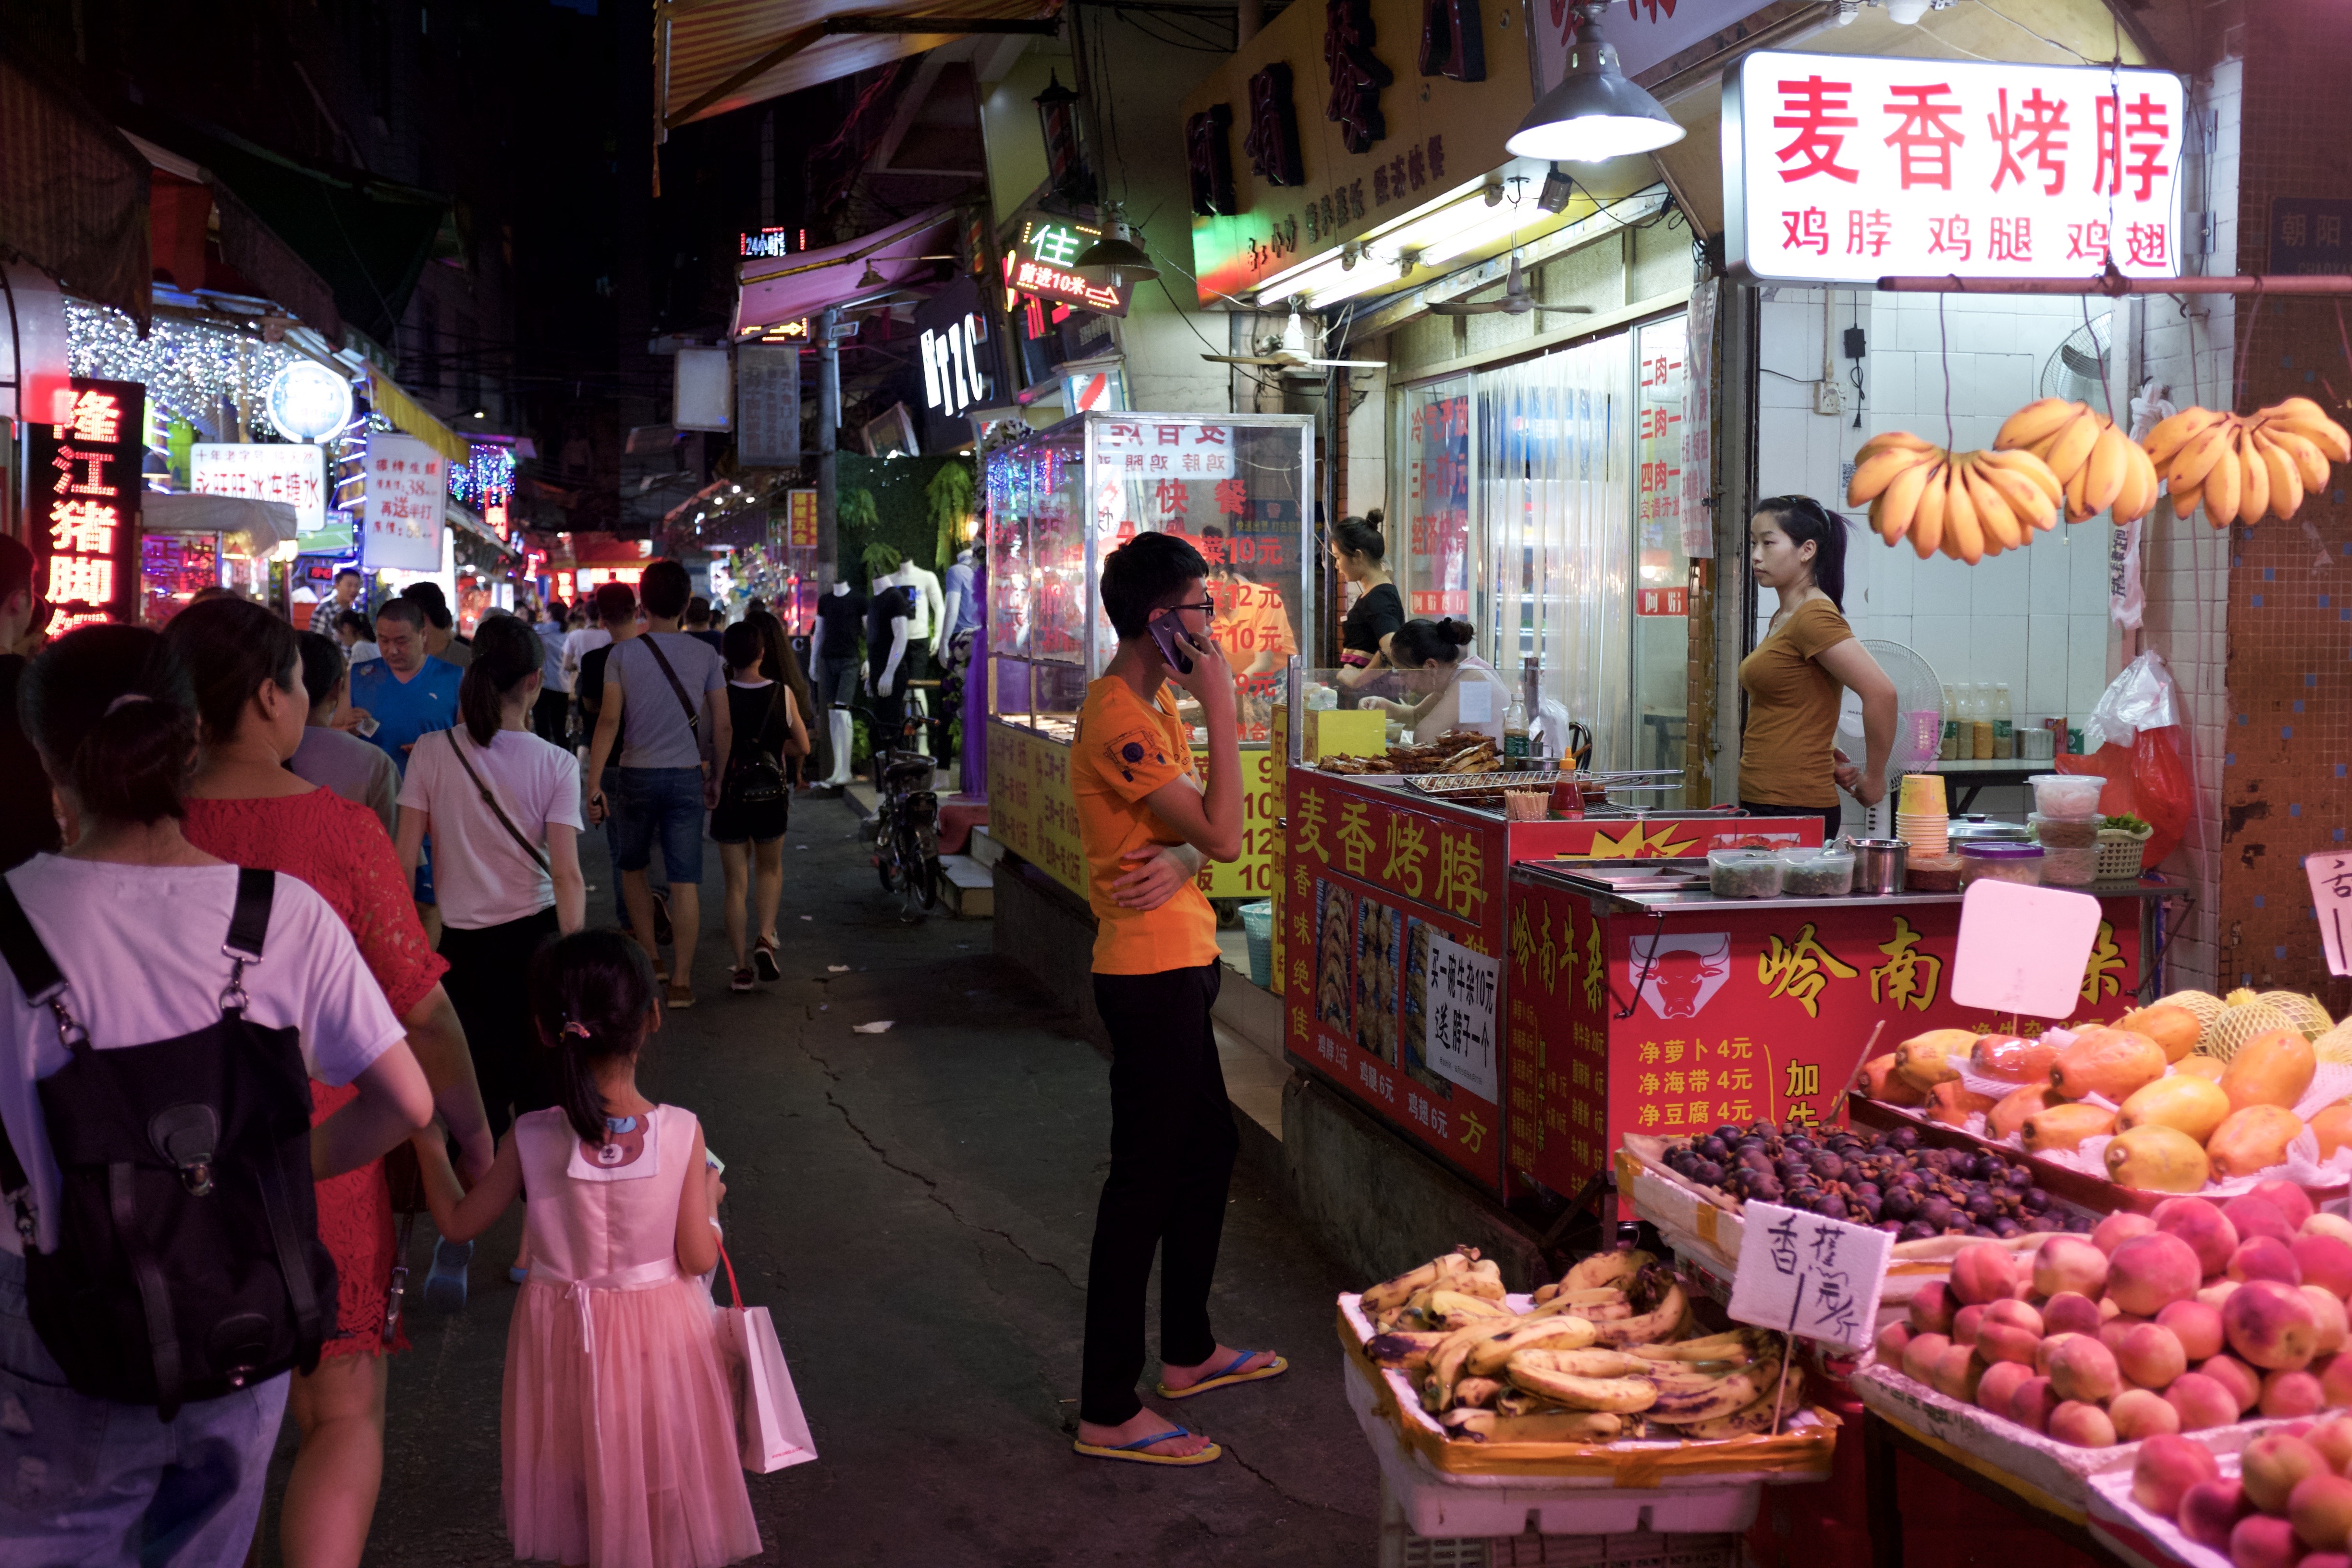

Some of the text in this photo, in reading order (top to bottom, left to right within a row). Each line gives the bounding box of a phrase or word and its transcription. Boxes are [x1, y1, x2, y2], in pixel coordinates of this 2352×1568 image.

[1773, 74, 2170, 202] 麦香烤脖
[1781, 206, 2168, 267] 鸡脖 鸡腿 鸡翅
[1018, 262, 1086, 294] 前进10米
[1236, 672, 1276, 697] 9元
[1296, 787, 1488, 919] 麦香烤脖
[1292, 865, 1311, 1042] 香味绝佳
[1431, 947, 1494, 1015] 买一碗牛杂10元
[1512, 897, 1606, 1016] 岭南牛杂
[1758, 916, 2126, 1018] 岭南杂
[1435, 1002, 1489, 1068] 送脖子一个
[1638, 1037, 1753, 1065] 净萝卜 4元
[1638, 1068, 1753, 1096] 净海带 4元
[1638, 1099, 1753, 1127] 净豆腐 4元
[1431, 1108, 1448, 1139] 6元
